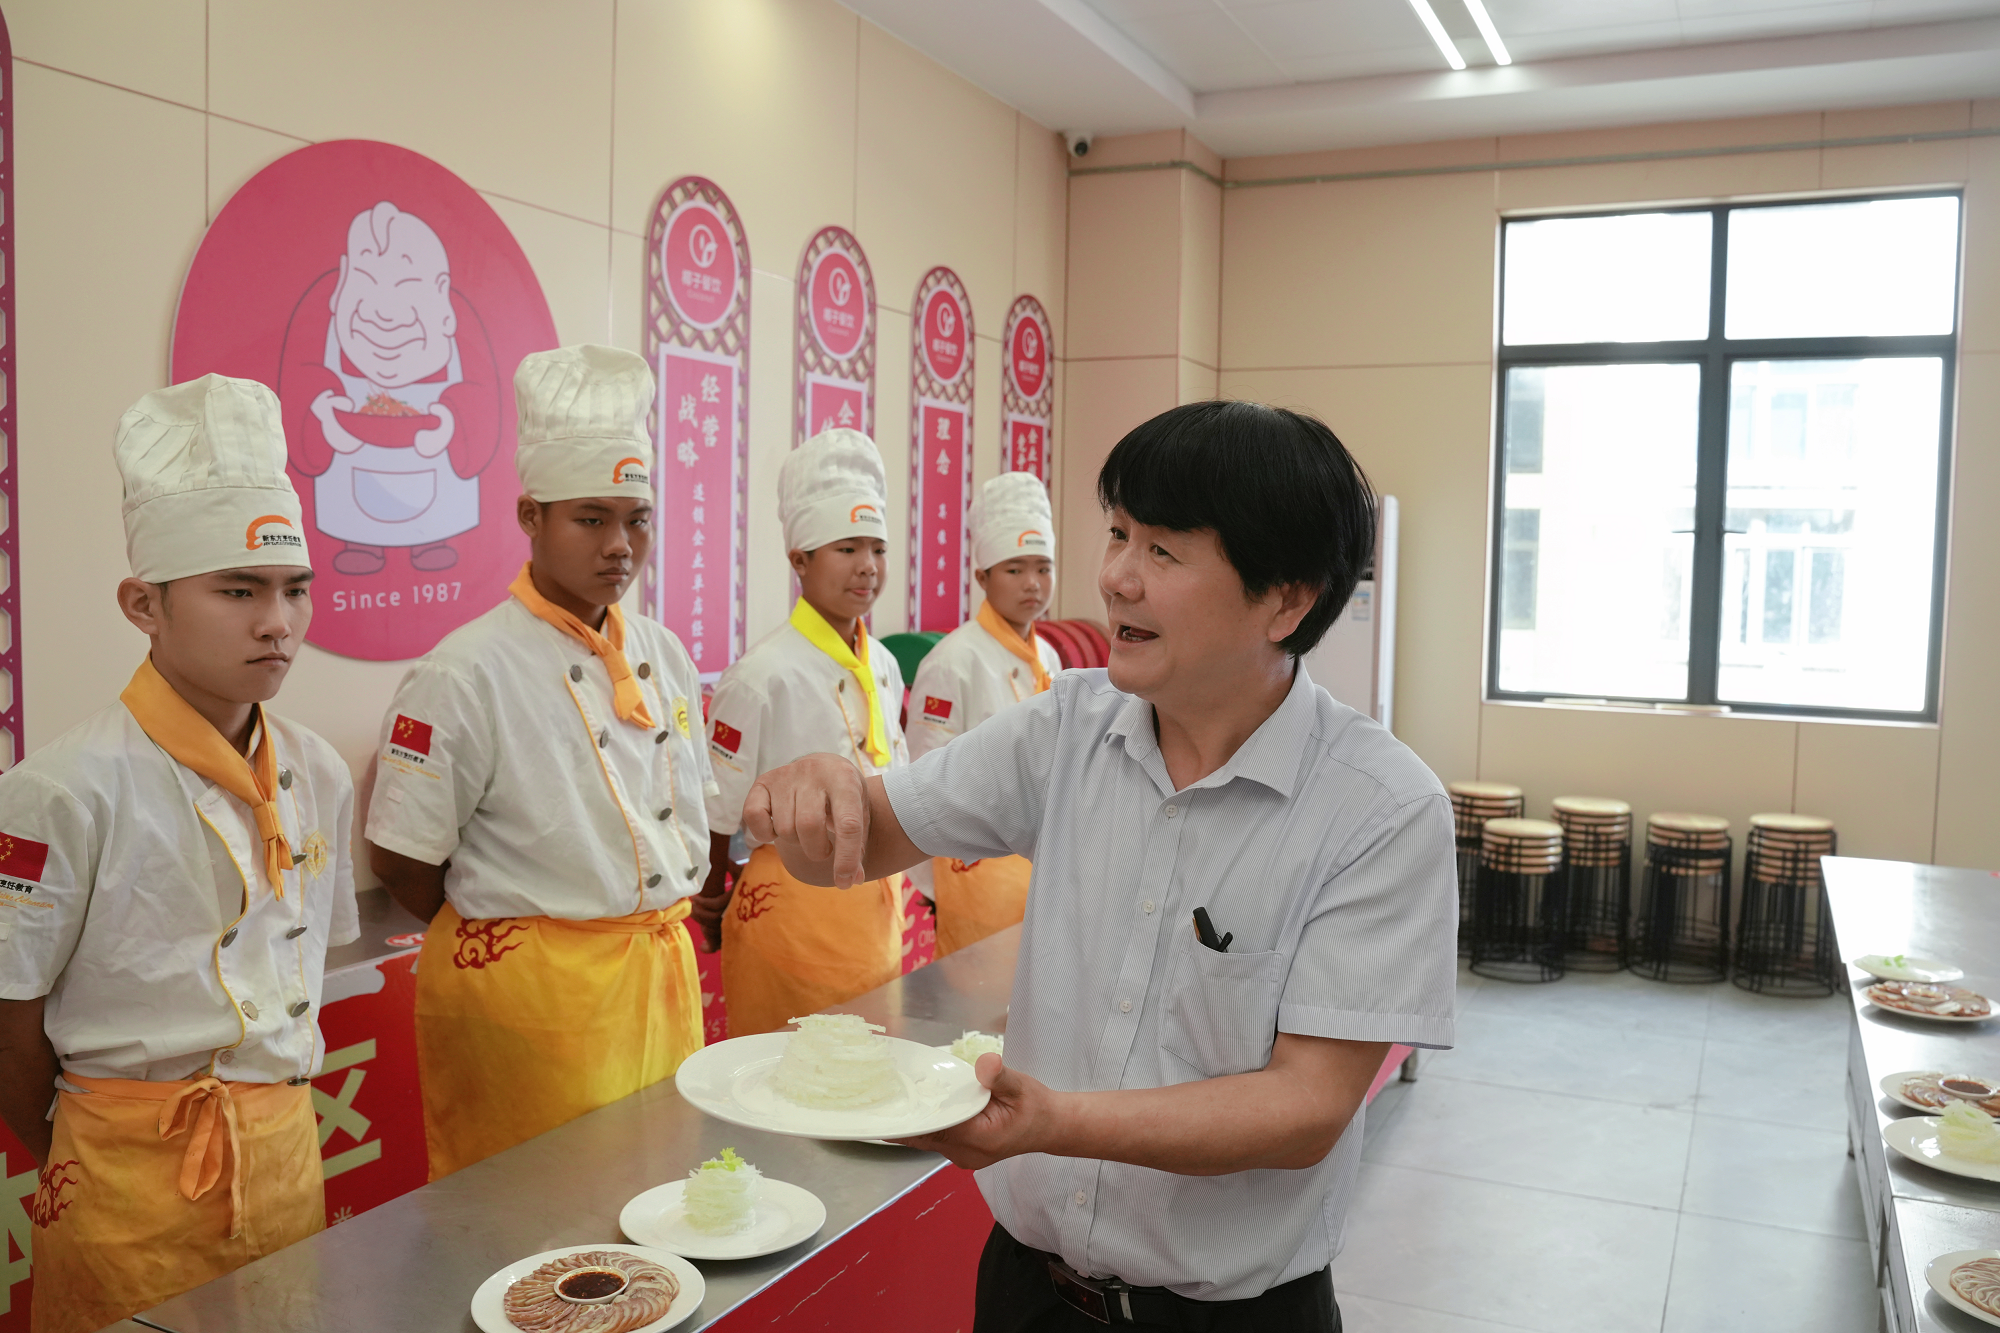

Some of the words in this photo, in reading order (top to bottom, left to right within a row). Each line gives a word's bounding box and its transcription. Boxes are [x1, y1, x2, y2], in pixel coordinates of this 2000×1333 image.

[677, 393, 699, 469] 战略
[701, 372, 720, 448] 经营
[936, 416, 951, 476] 理念
[332, 590, 401, 612] Since
[412, 581, 462, 604] 1987
[691, 482, 705, 661] 连锁企业单店经营
